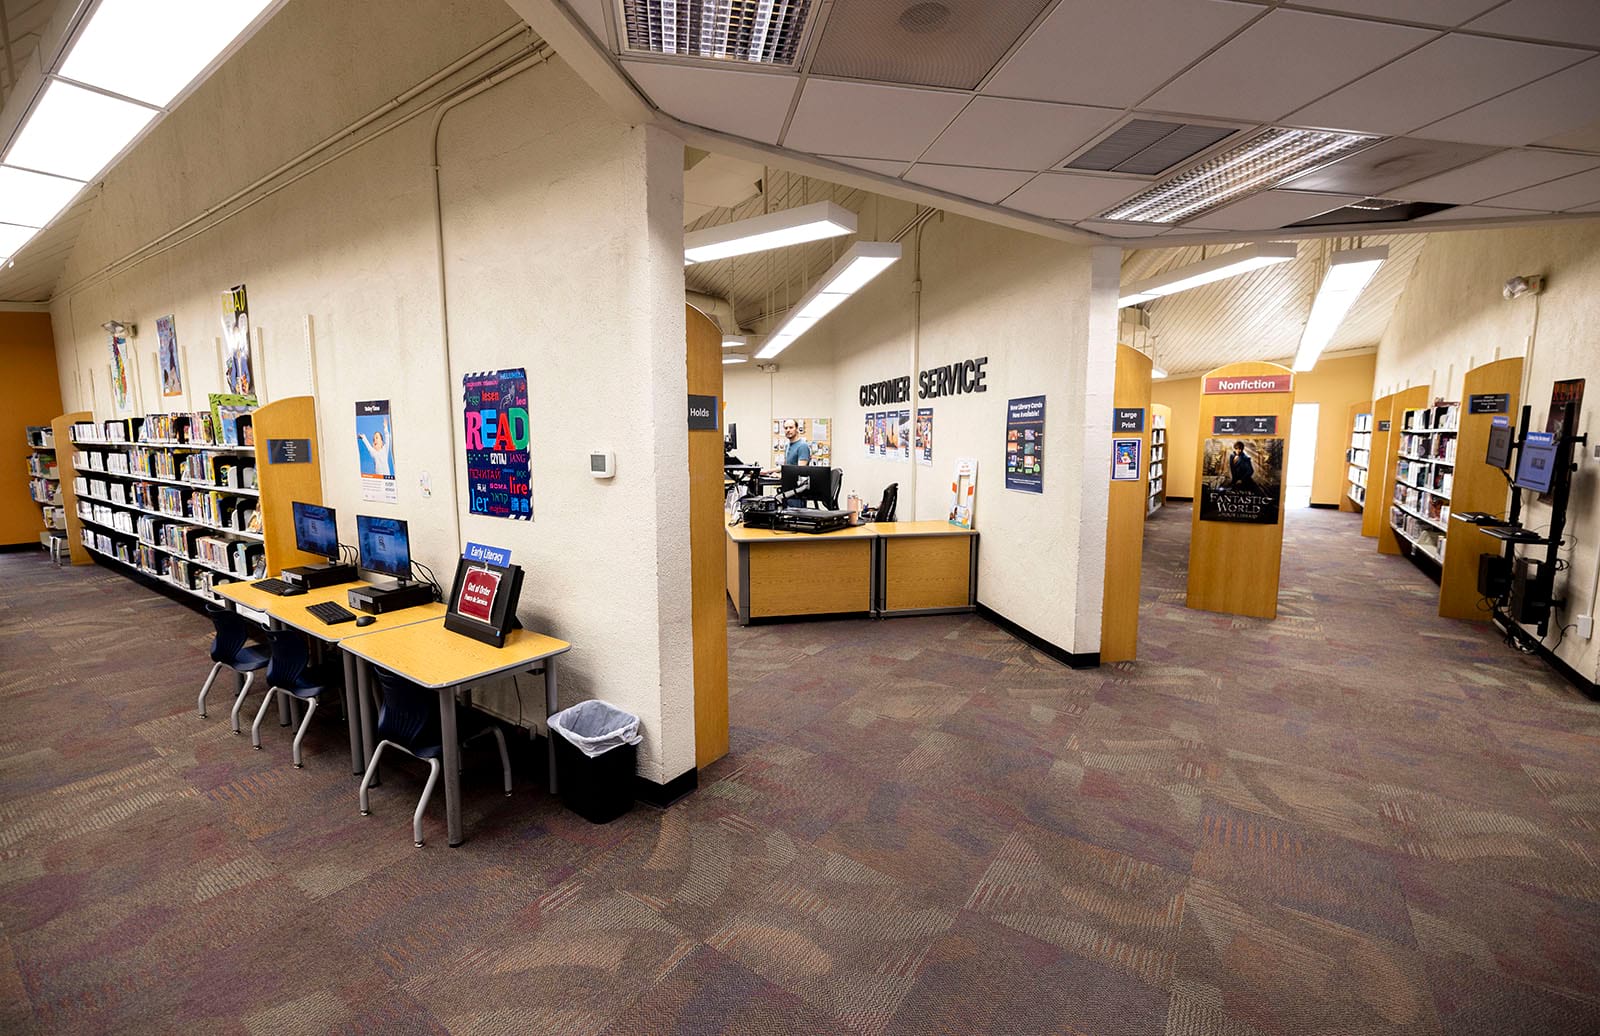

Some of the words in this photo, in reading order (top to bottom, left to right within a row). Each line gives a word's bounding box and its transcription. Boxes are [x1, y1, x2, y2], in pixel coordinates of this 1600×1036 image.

[860, 376, 910, 406] CUSTOMER
[918, 356, 988, 399] SERVICE
[1218, 379, 1276, 391] Nonfiction
[690, 408, 710, 417] Holds
[1120, 411, 1137, 420] Large
[466, 408, 529, 450] READ
[509, 475, 529, 495] lire
[471, 488, 489, 513] ler
[1210, 492, 1273, 505] FANTASTIC
[1217, 502, 1261, 514] WORLD
[471, 546, 482, 559] Early
[484, 548, 504, 563] Literacy
[468, 582, 476, 592] Out
[479, 586, 491, 596] Order
